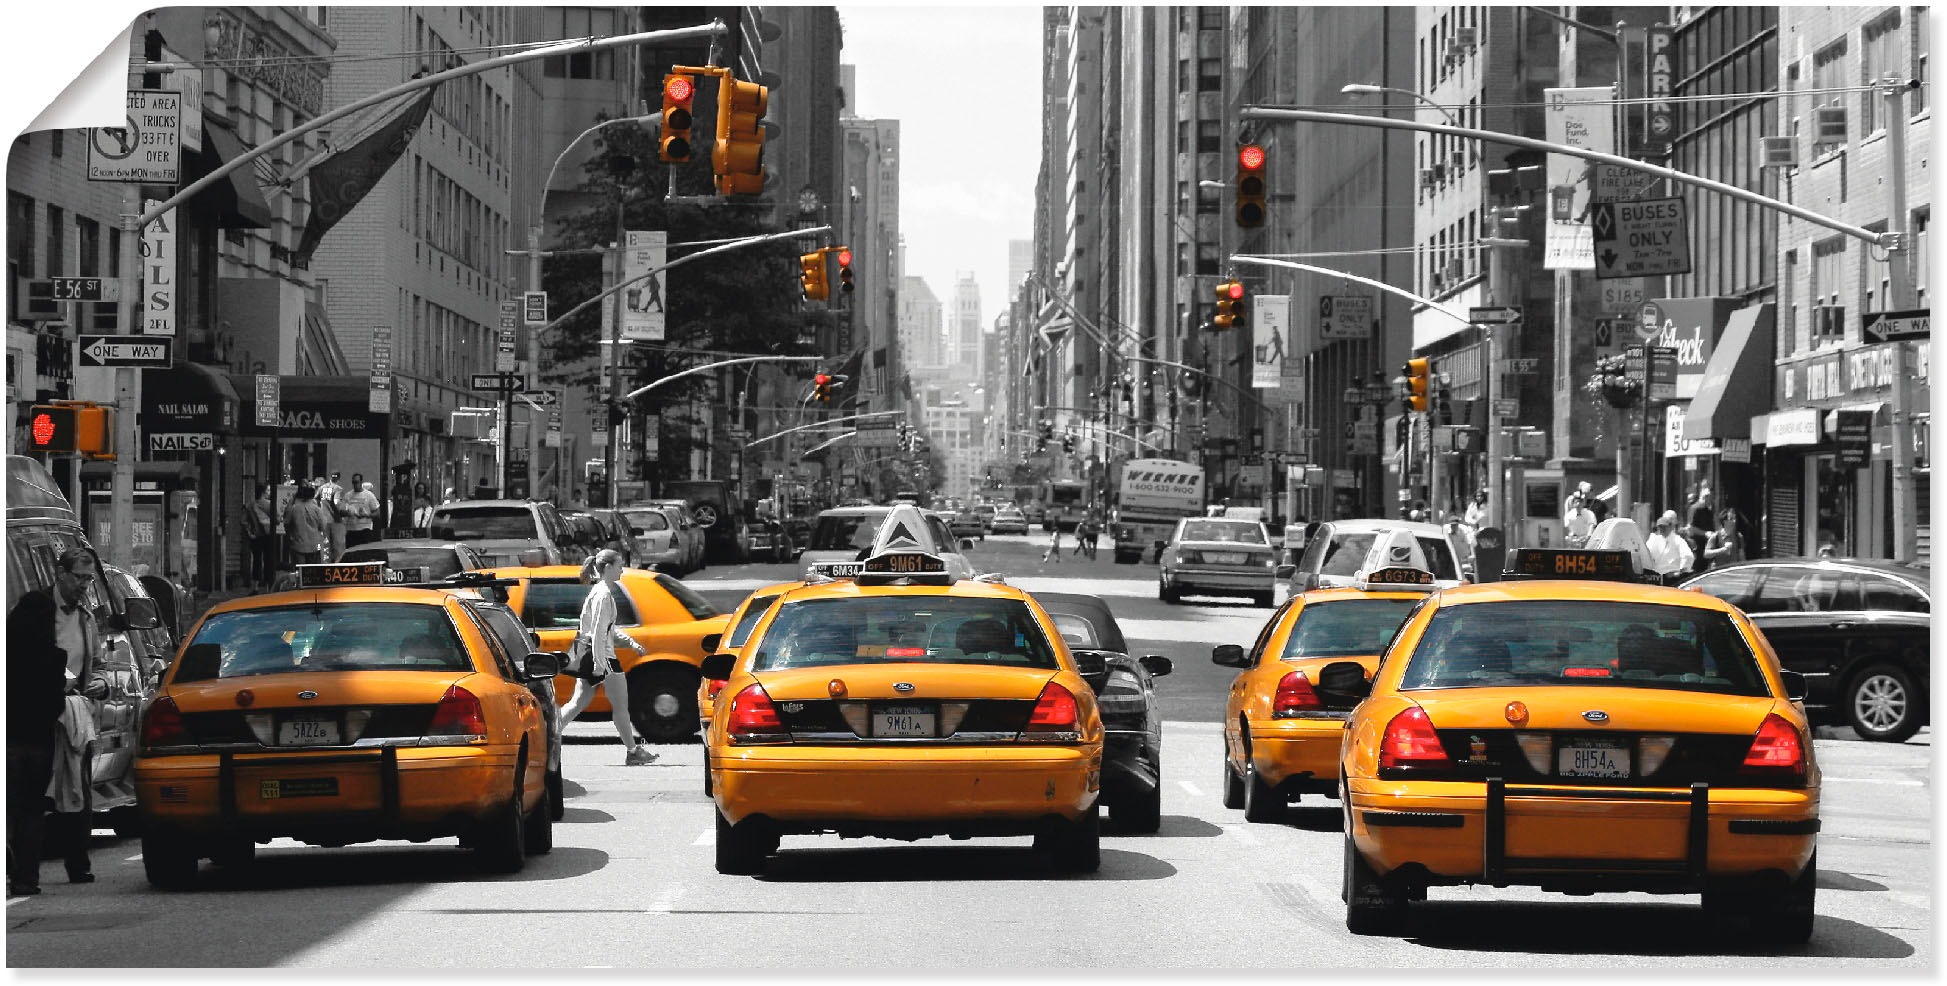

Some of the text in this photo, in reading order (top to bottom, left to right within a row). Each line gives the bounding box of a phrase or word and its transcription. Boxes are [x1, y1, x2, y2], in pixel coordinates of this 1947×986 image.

[1652, 33, 1671, 112] PARK
[152, 99, 176, 109] AREA
[143, 115, 176, 127] TRUCKS
[146, 150, 169, 162] OVER
[1621, 203, 1678, 221] BUSES
[1629, 230, 1673, 248] ONLY
[150, 199, 170, 311] AILS
[54, 280, 98, 298] E 56 ST
[150, 319, 170, 329] 2FL
[1876, 318, 1929, 333] ONE WA
[93, 346, 158, 357] ONE WAY
[158, 403, 209, 414] NAIL SALON
[278, 411, 366, 429] SAGA SHOES
[151, 435, 199, 450] NAILS
[890, 555, 922, 571] 9M61
[1555, 553, 1597, 575] 8H54
[324, 566, 359, 582] 5A22
[832, 565, 859, 577] 6M34
[1386, 570, 1416, 582] 6G73
